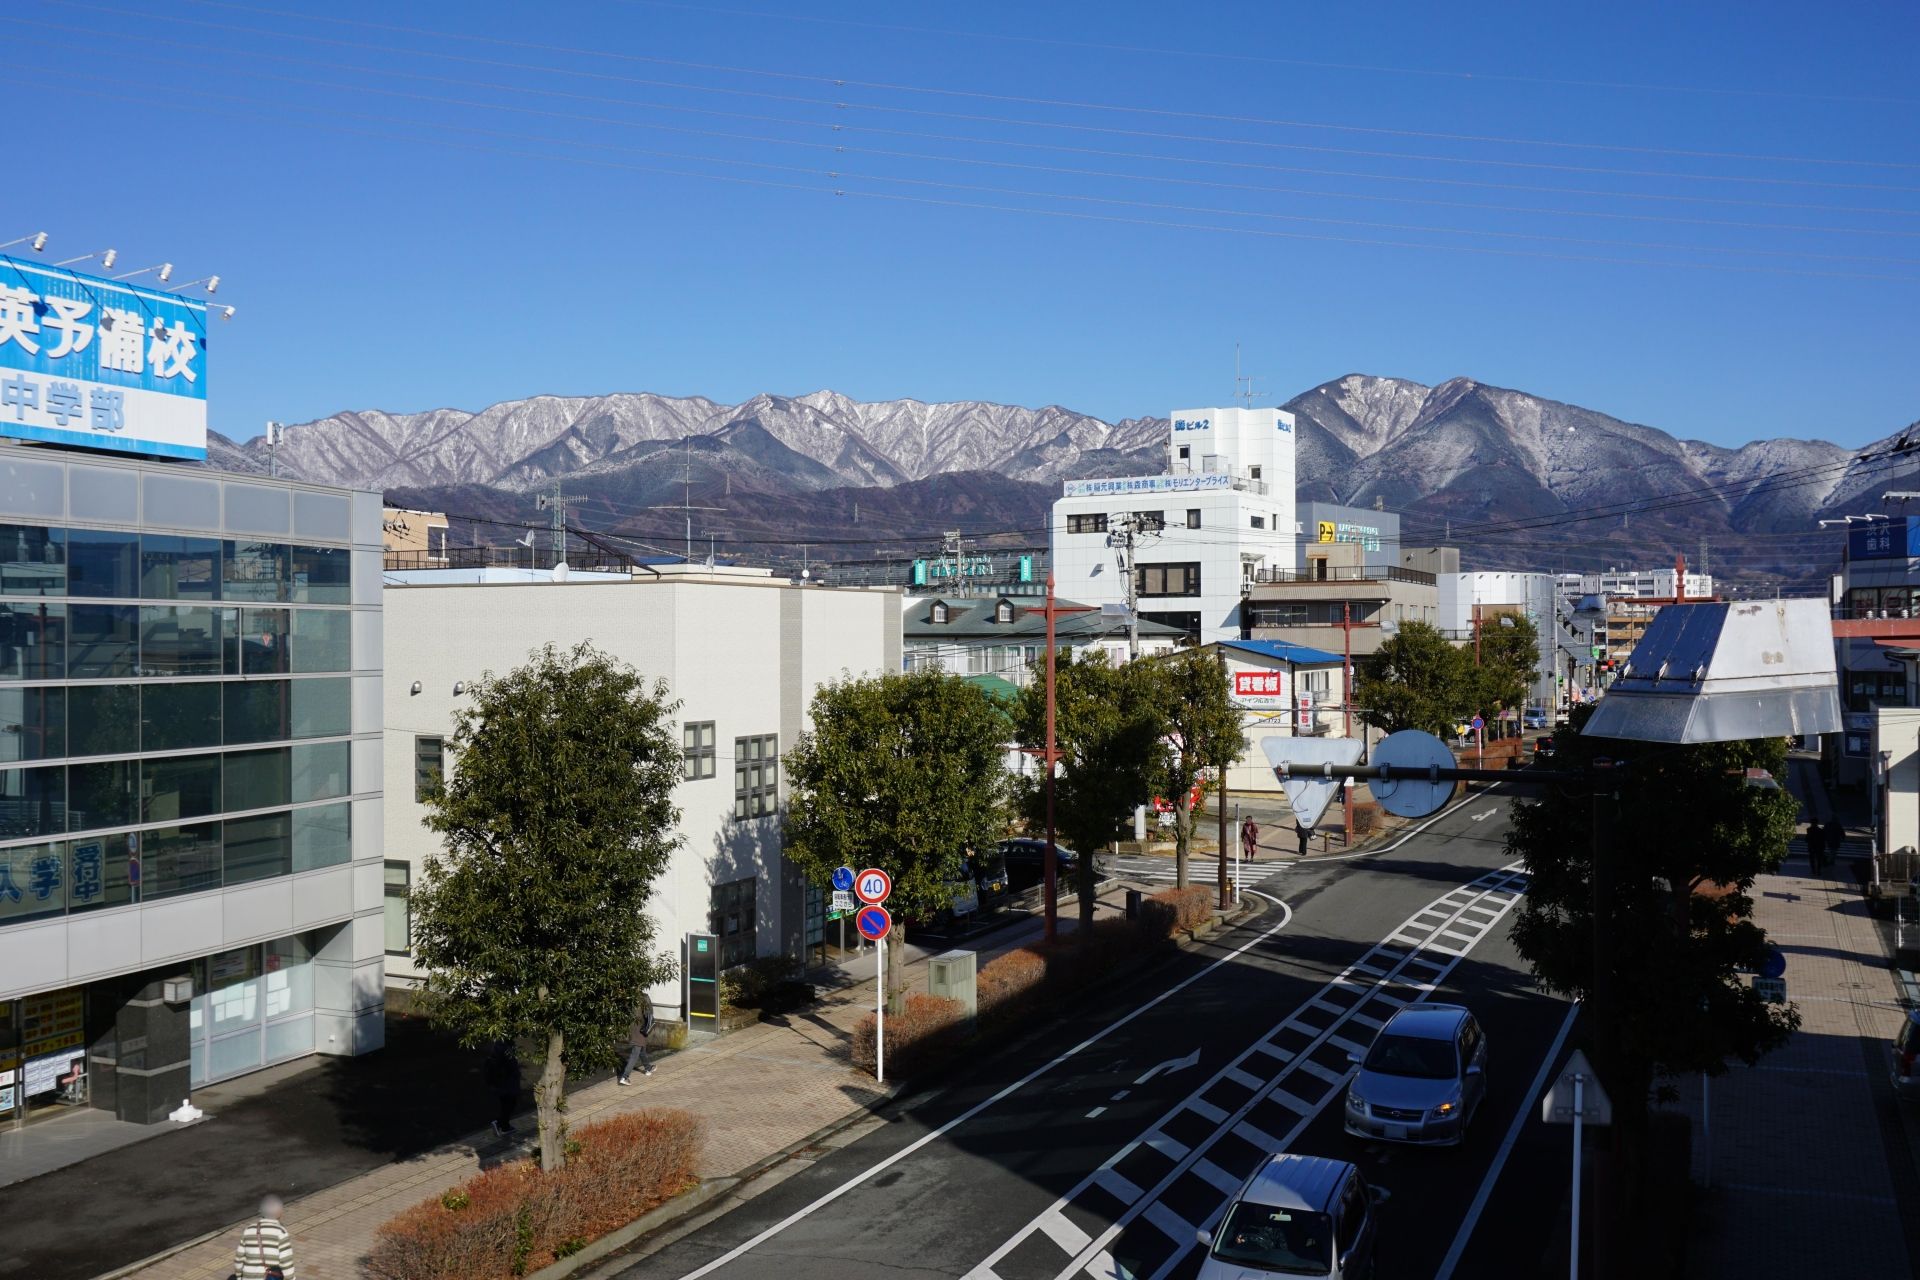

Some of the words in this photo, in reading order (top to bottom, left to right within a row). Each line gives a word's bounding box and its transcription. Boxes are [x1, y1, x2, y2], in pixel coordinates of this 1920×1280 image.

[0, 283, 197, 383] 英予備校
[2, 374, 126, 432] 中学部
[1319, 523, 1326, 542] P
[1866, 537, 1890, 551] 歯科
[1238, 676, 1278, 692] 貸看板
[72, 842, 102, 902] 受付中
[864, 879, 882, 894] 40
